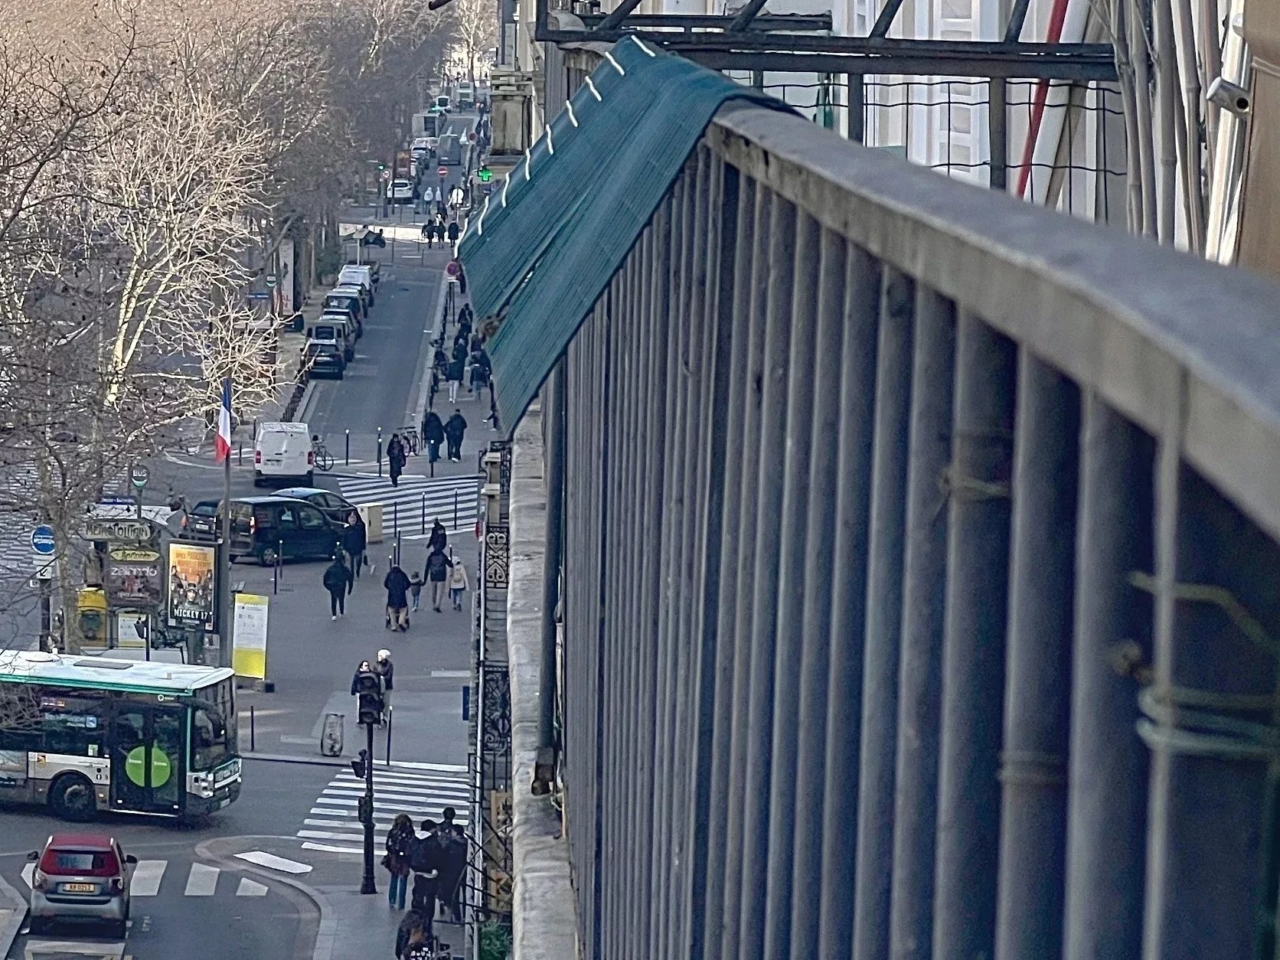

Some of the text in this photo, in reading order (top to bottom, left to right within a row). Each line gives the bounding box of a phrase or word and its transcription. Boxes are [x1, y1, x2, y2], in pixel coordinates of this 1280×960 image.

[132, 469, 147, 477] BUS
[174, 608, 208, 620] MICKEY 17
